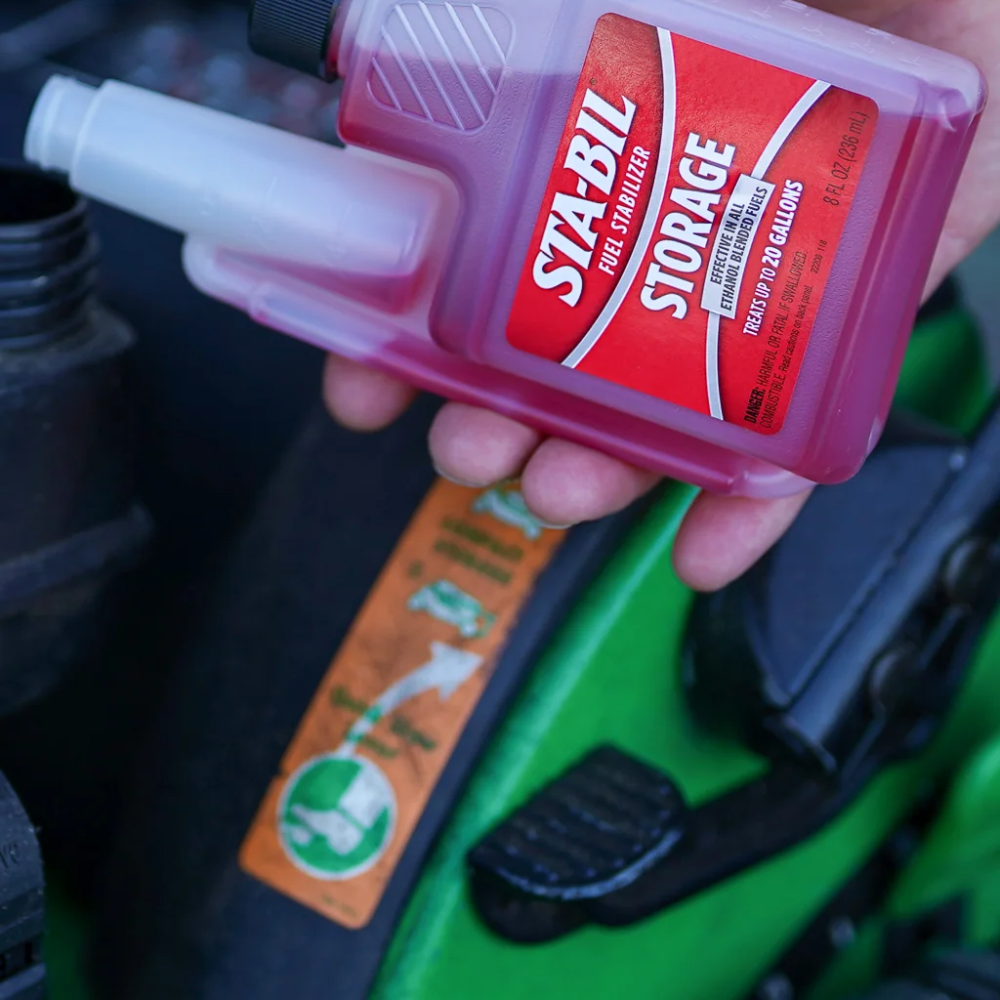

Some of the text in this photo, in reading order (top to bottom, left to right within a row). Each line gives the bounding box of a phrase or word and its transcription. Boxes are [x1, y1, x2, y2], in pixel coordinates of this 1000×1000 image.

[532, 87, 636, 307] STA-BIL
[597, 145, 650, 275] FUEL STABILIZER
[821, 110, 870, 206] 8 FL OZ (236 mL)
[639, 131, 736, 319] STORAGE
[709, 202, 745, 285] EFFECTIVE IN ALL
[719, 185, 768, 311] ETHANOL BLENDED FUELS
[742, 178, 803, 336] TREATS UP TO 20 GALLONS
[742, 250, 807, 424] DANGER: HARMFUL OR FATAL IF SWALLOWED.
[777, 354, 792, 372] Read
[784, 328, 800, 356] cautions
[792, 318, 802, 329] on
[794, 303, 807, 320] back
